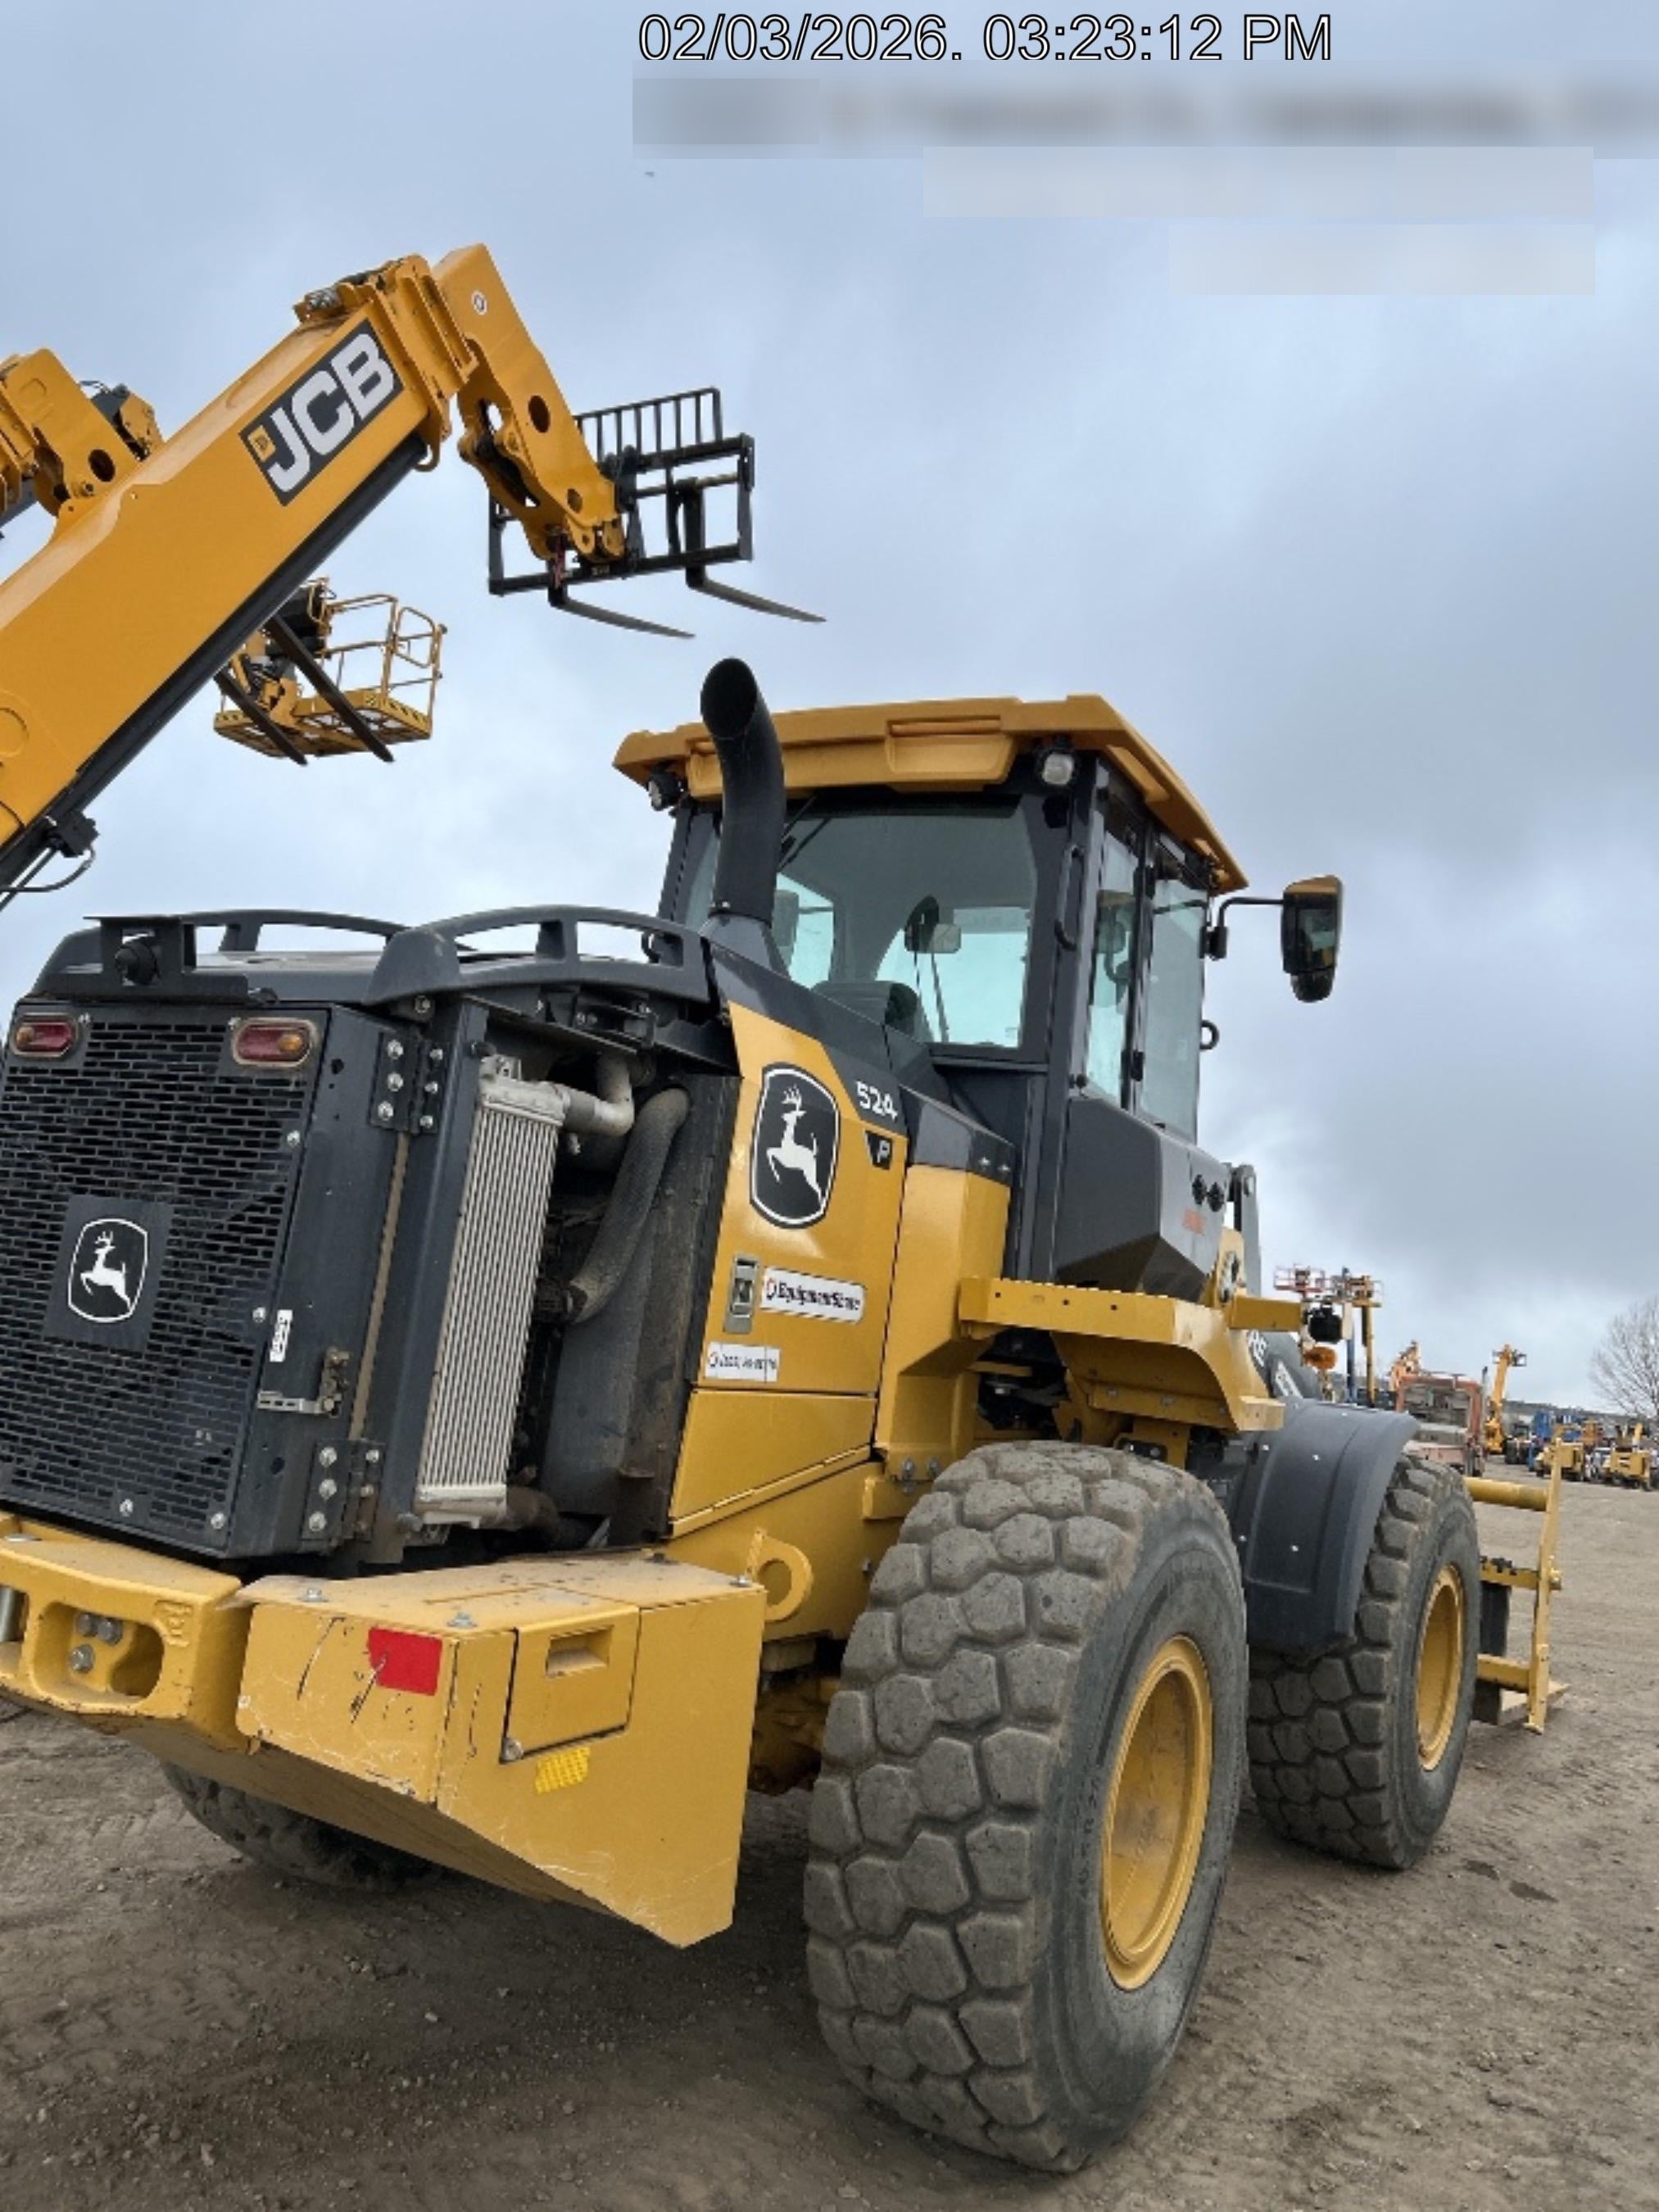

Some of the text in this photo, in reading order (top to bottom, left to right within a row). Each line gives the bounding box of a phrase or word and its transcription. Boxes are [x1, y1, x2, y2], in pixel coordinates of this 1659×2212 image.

[266, 333, 394, 492] JCB
[856, 1081, 898, 1121] 524
[877, 1140, 891, 1163] P
